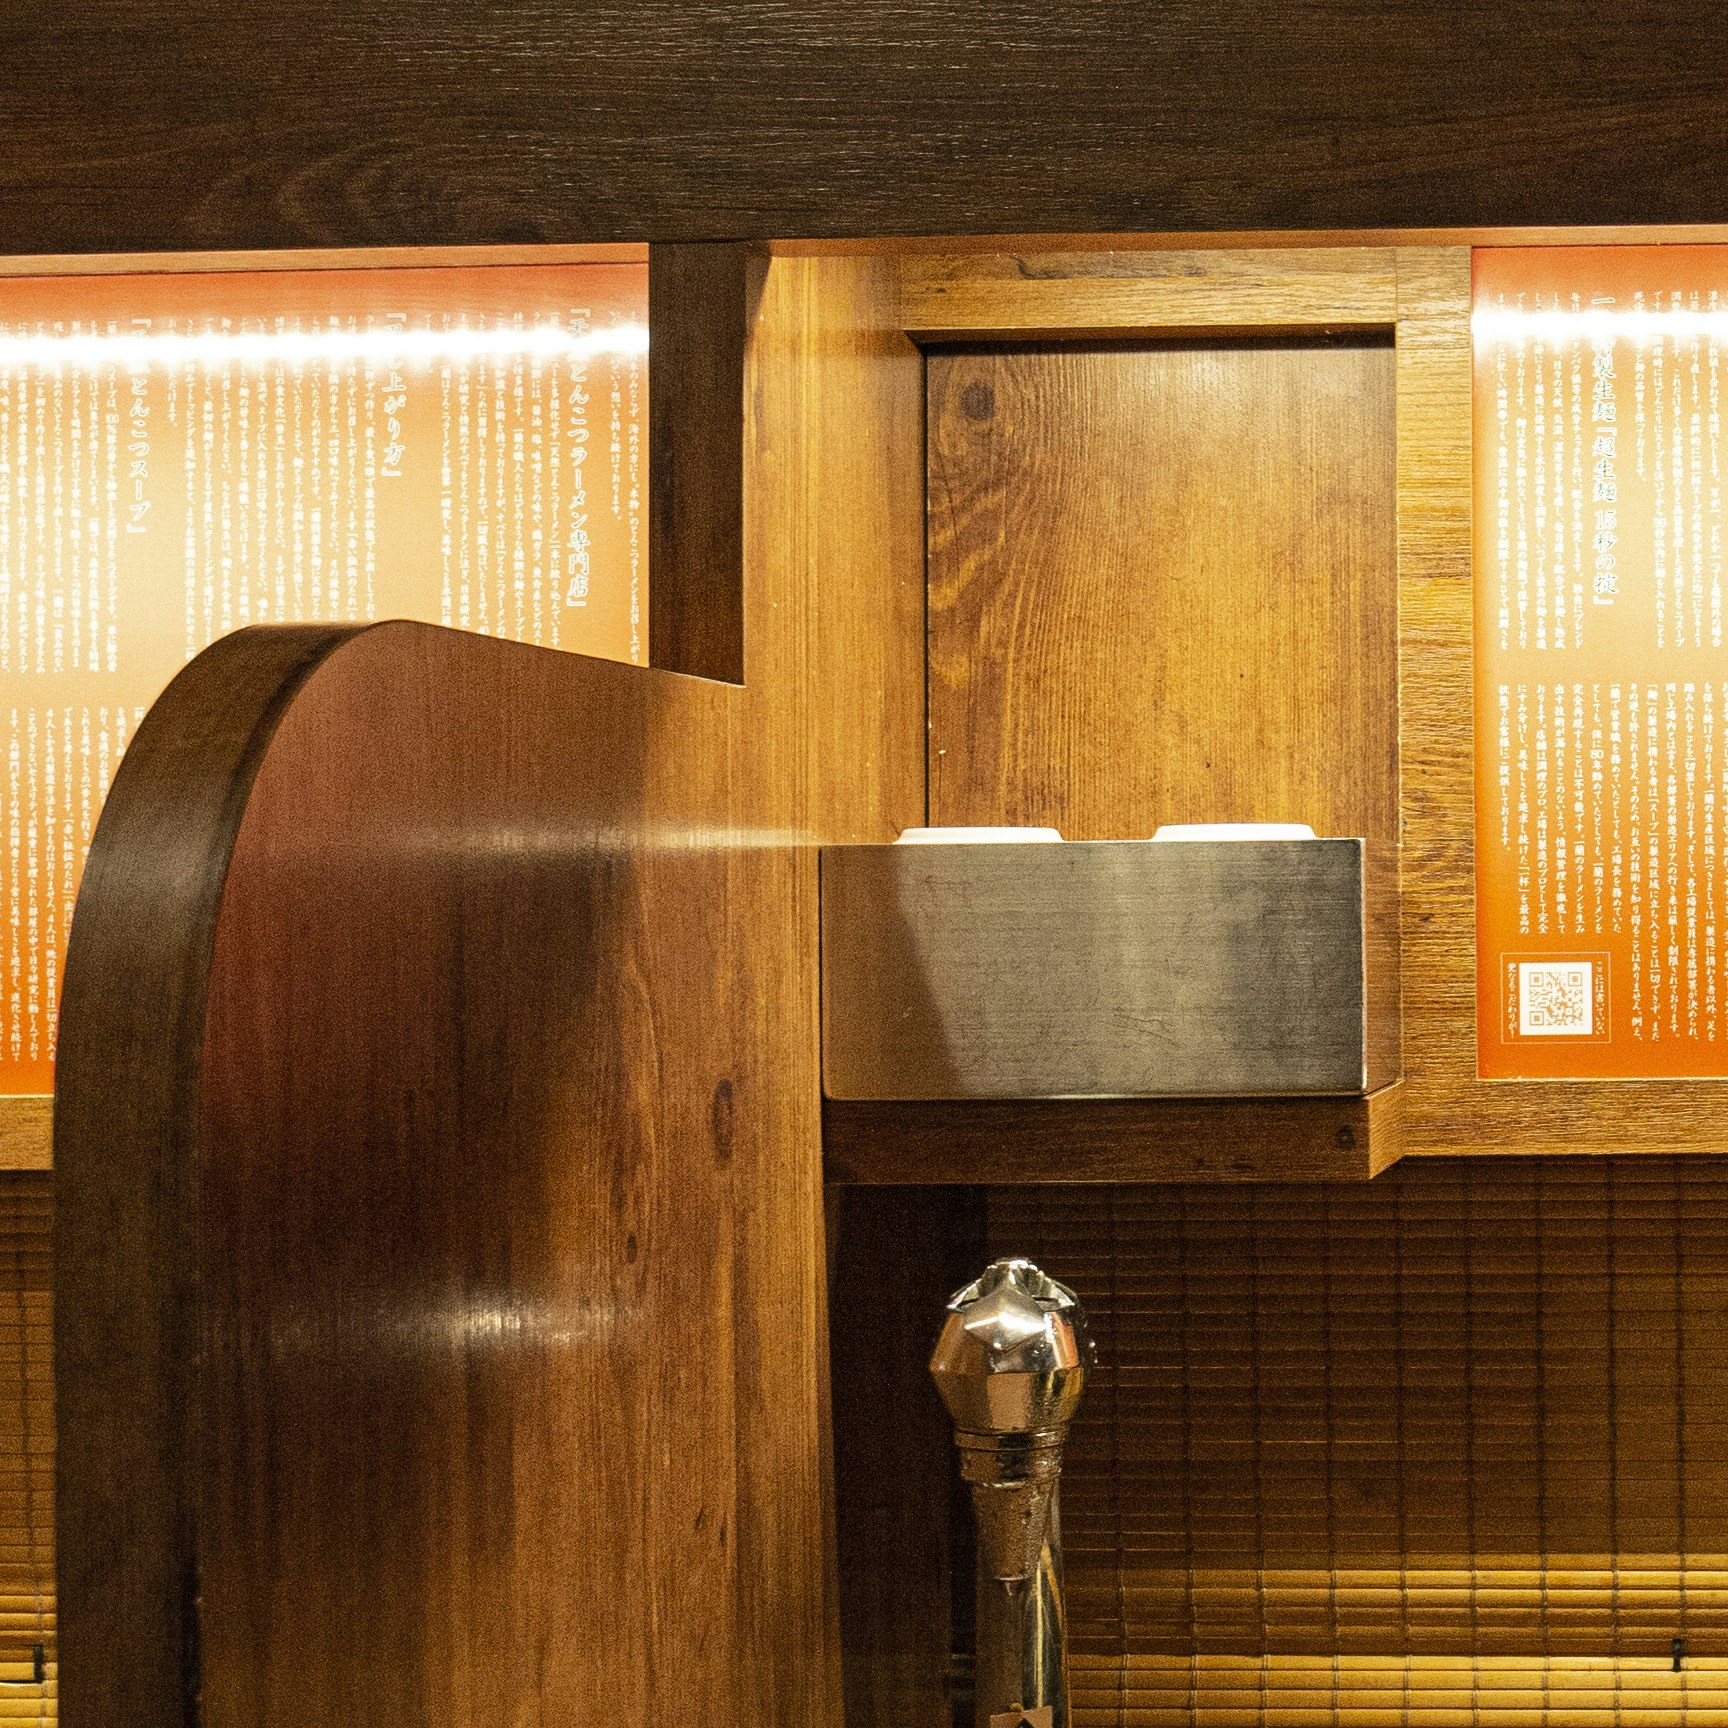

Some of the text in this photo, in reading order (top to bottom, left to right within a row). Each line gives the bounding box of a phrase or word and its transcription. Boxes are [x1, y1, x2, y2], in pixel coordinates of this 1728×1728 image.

[567, 308, 591, 607] 『天とんこつラーメン専門店』
